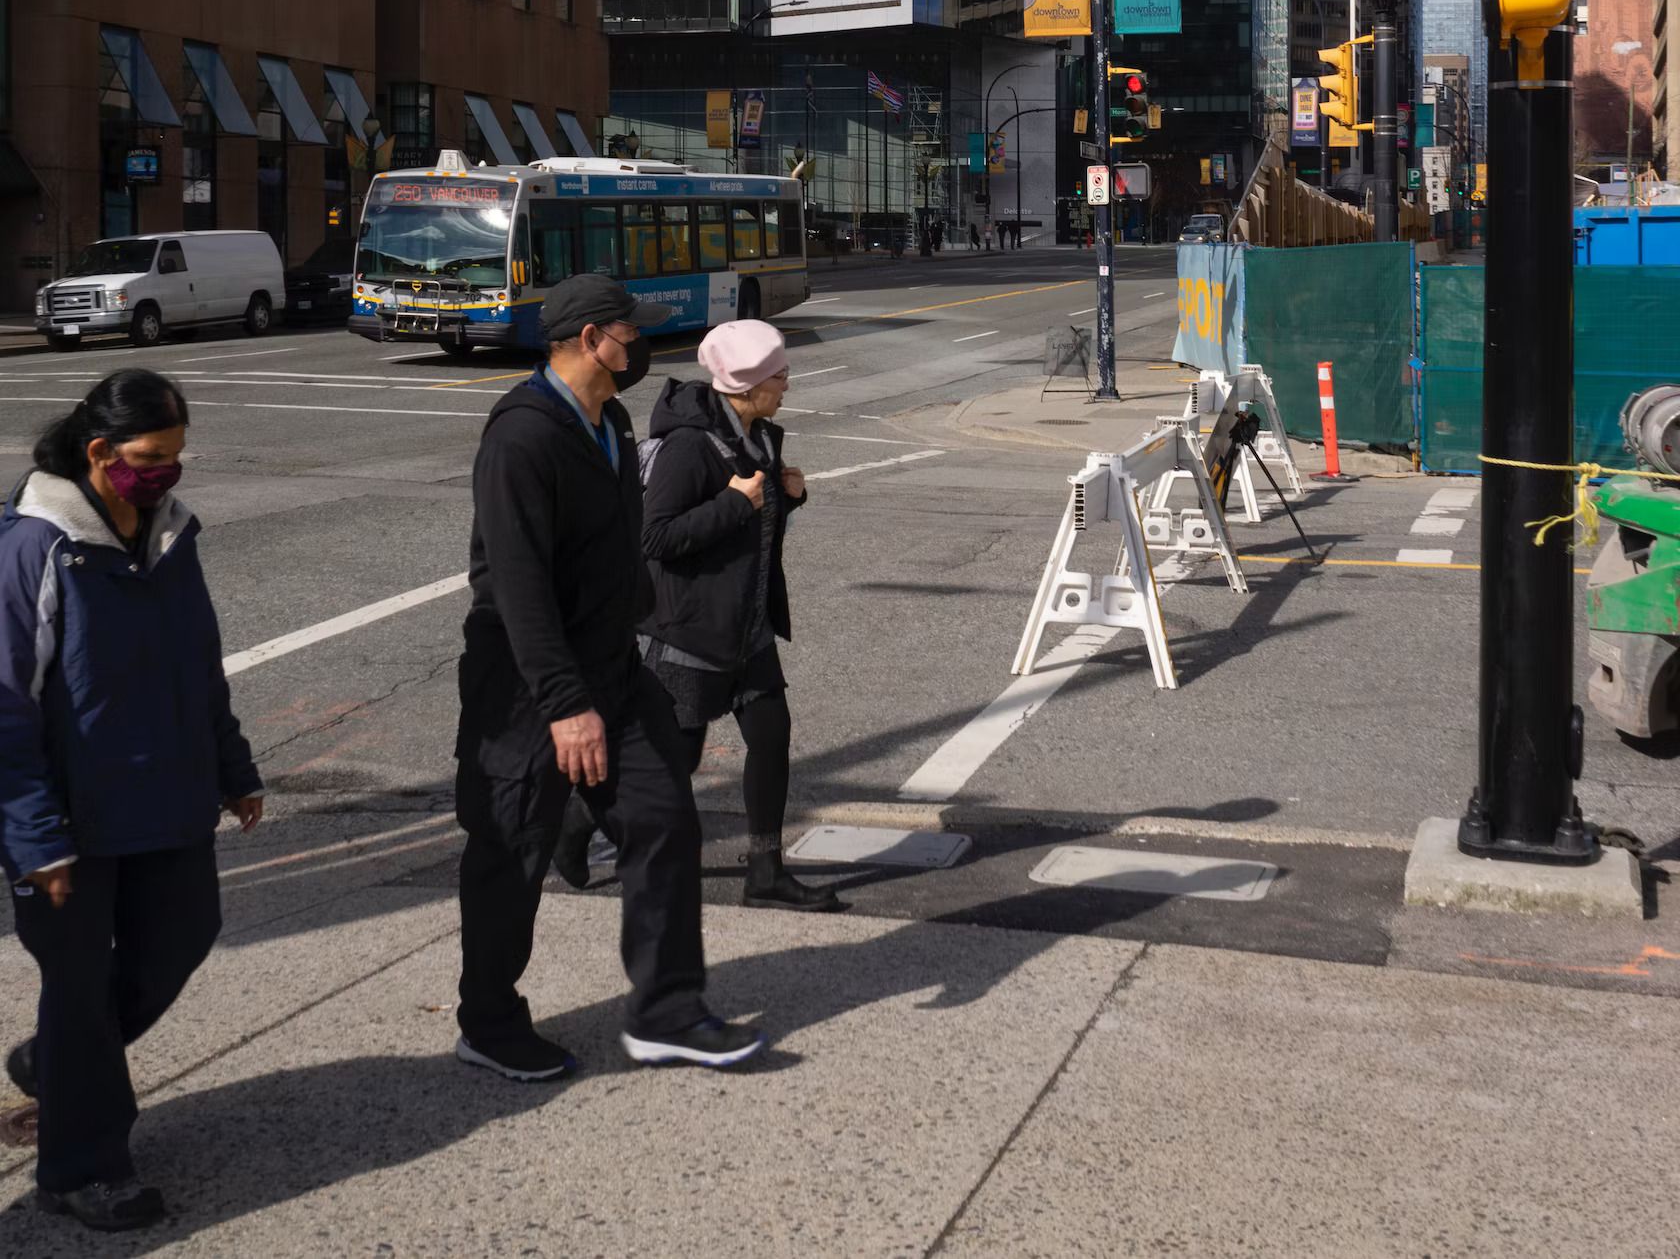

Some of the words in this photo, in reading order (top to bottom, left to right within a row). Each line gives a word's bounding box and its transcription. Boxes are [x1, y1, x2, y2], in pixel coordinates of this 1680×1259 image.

[1033, 6, 1080, 16] downtown
[1123, 4, 1171, 14] downtown
[1410, 170, 1420, 182] P
[616, 179, 638, 191] Instant
[394, 185, 422, 202] 250
[428, 186, 499, 203] VANCOUVER
[663, 290, 679, 302] never
